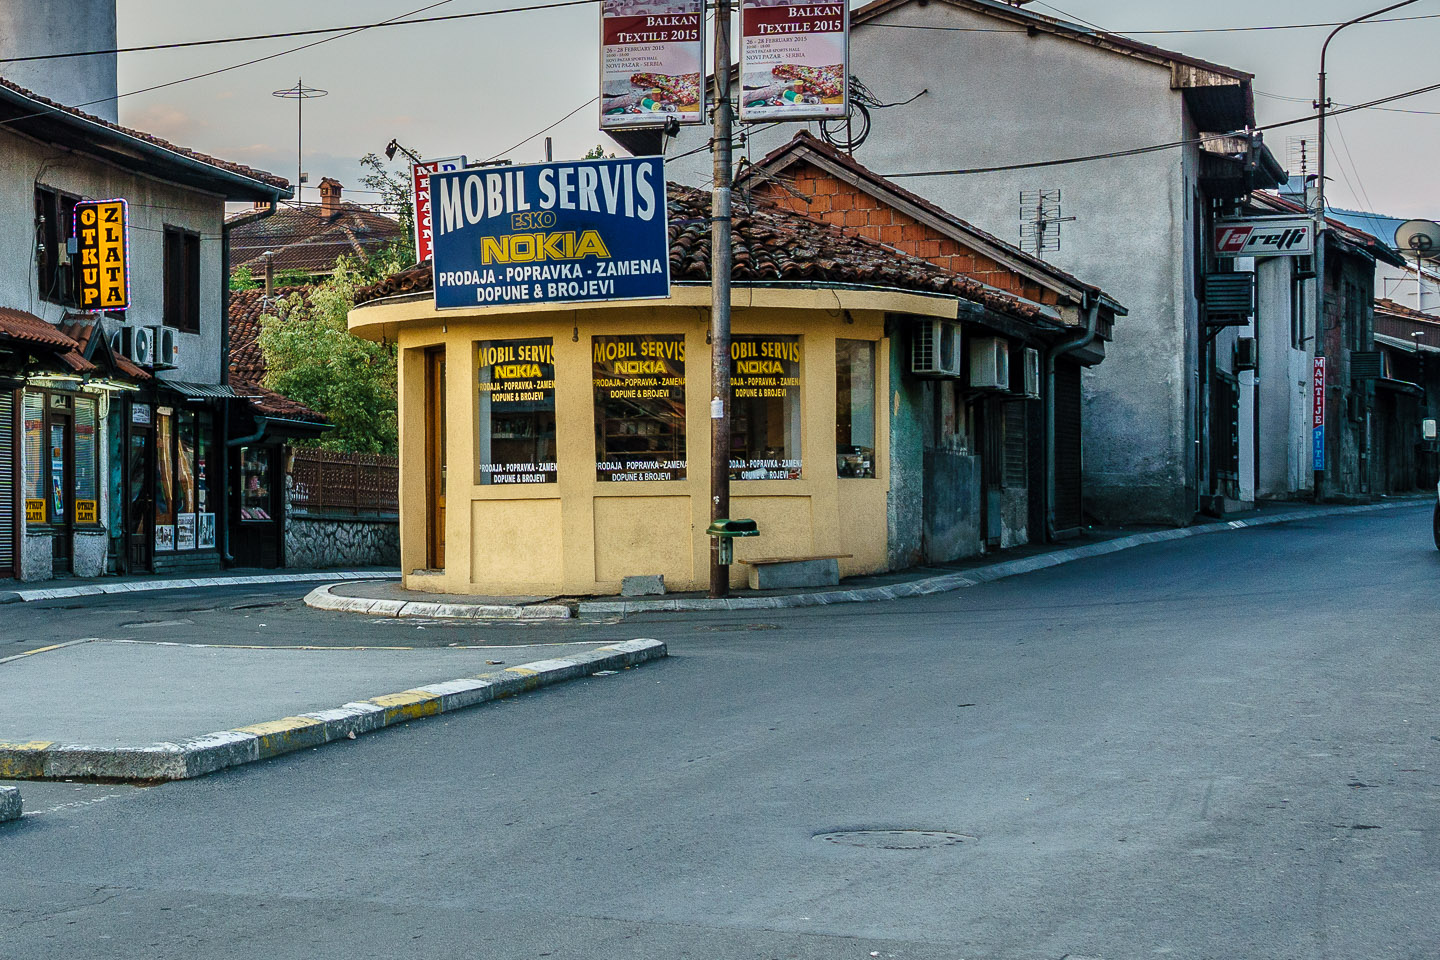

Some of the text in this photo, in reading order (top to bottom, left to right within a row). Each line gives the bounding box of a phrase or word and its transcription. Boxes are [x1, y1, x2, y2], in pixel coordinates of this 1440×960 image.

[788, 6, 841, 17] BALKAN
[646, 16, 697, 26] BALKAN
[758, 20, 841, 33] TEXTILE 2015
[617, 29, 697, 43] TEXTILE 2015
[440, 162, 656, 235] MOBIL SERVIS
[511, 211, 557, 231] ESKO
[480, 230, 611, 265] NOKIA
[81, 209, 99, 305] OTKUP
[104, 208, 123, 302] ZLATA
[439, 269, 496, 287] PRODAJA
[506, 263, 583, 282] POPRAVKA
[596, 259, 663, 277] ZAMENA
[477, 280, 615, 302] DOPUNE & BROJEVI
[478, 346, 515, 368] MOBIL
[593, 341, 685, 363] MOBIL SERVIS
[731, 342, 800, 363] OBIL SERVIS
[494, 364, 542, 379] NOKIA
[614, 360, 668, 374] NOKIA
[736, 360, 785, 374] NOKIA
[478, 382, 501, 391] RODAJA
[504, 381, 533, 390] POPRAVKA
[625, 378, 658, 387] POPRAVKA
[747, 377, 777, 386] POPRAVKA
[780, 377, 800, 386] ZAMEN
[492, 392, 514, 402] DOPUNE
[520, 392, 544, 401] BROJEVI
[610, 390, 636, 398] DOPUNE
[643, 389, 669, 398] BROJEVI
[735, 388, 758, 397] DOPUNE
[763, 388, 787, 397] BROJEVI
[1314, 359, 1324, 424] MANTIJE
[1314, 430, 1322, 468] PITE
[506, 463, 535, 472] POPRAVKA
[626, 461, 659, 470] POPRAVKA
[749, 459, 778, 468] POPRAVKA
[493, 474, 516, 483] DOPUNE
[522, 473, 545, 482] BROJEVI
[611, 473, 637, 481] DOPUNE
[644, 472, 670, 481] BROJEVI
[769, 470, 789, 479] ROJEVI
[77, 501, 94, 510] OTKUP
[78, 512, 94, 520] ZLATA
